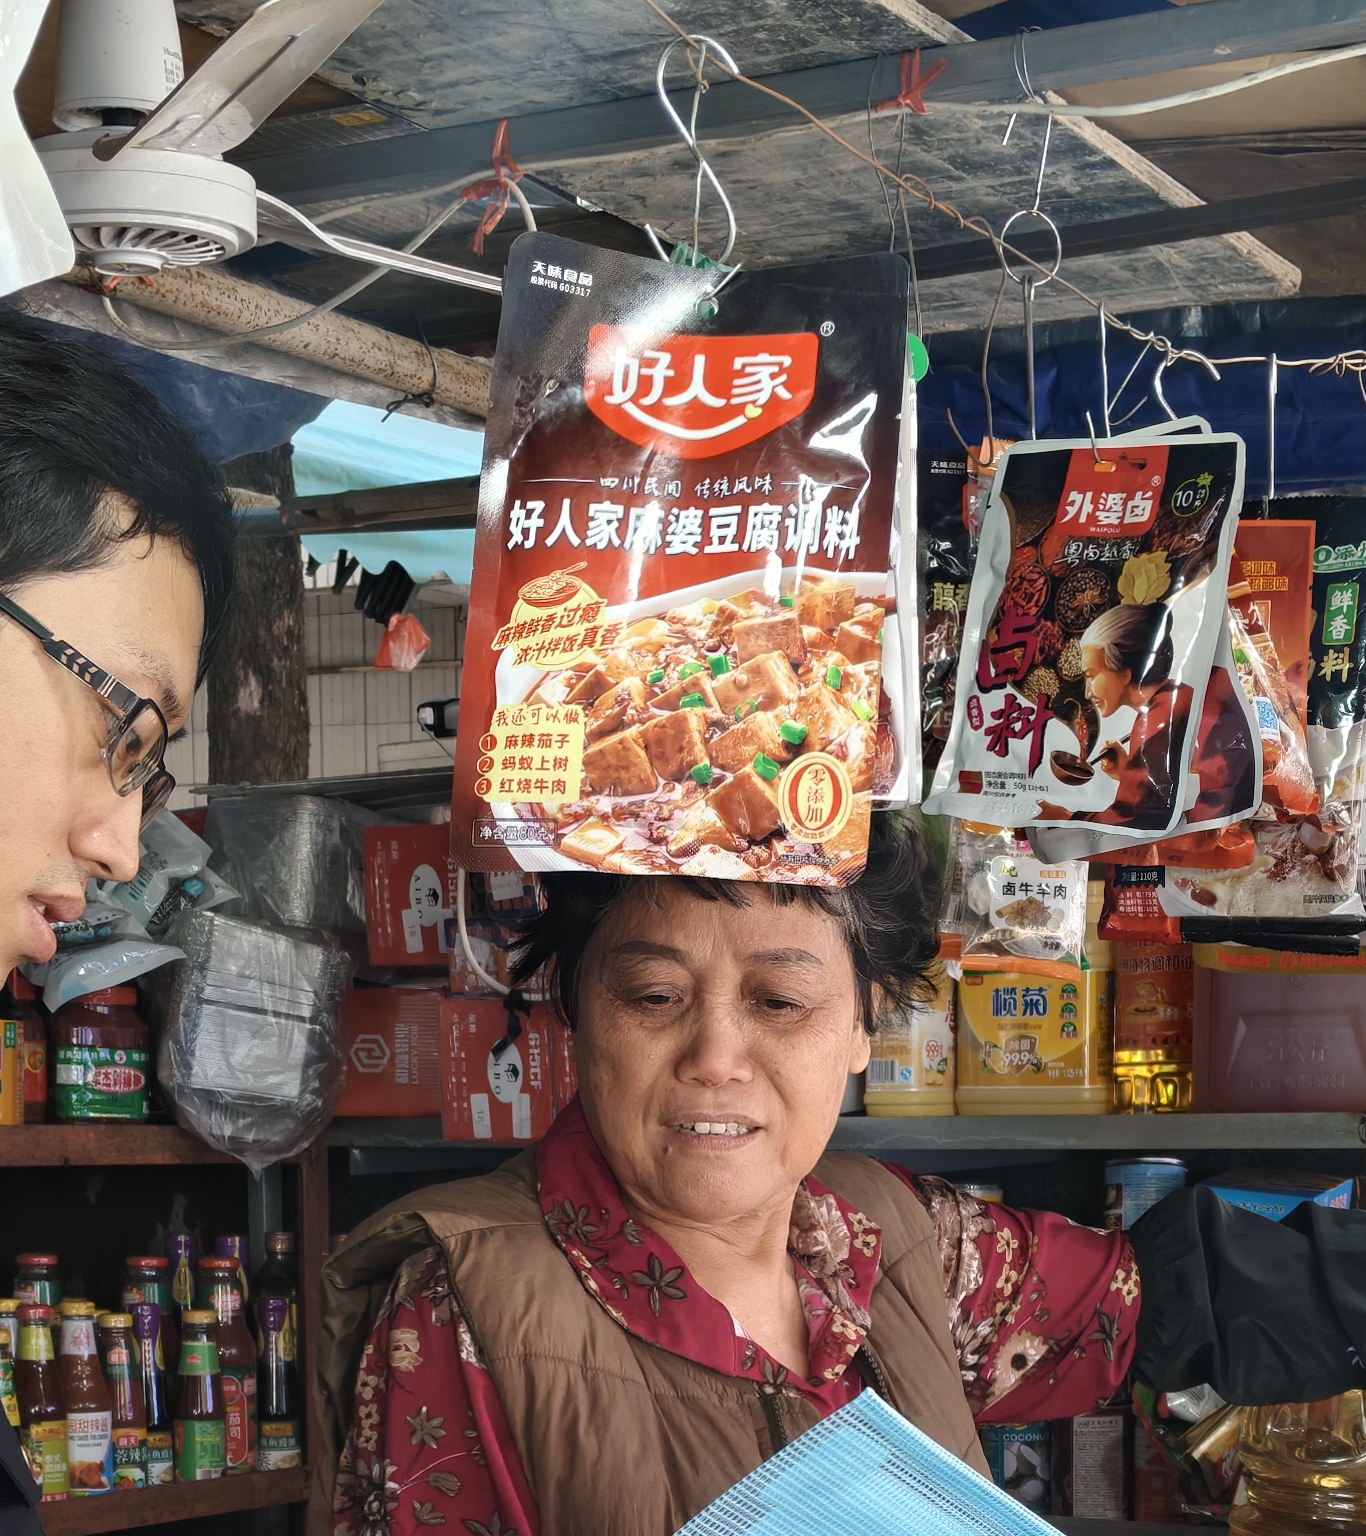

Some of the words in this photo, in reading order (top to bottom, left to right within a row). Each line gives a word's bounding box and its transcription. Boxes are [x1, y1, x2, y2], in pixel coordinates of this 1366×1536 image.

[531, 260, 593, 287] 天味食品
[558, 281, 592, 298] 603317
[603, 351, 794, 407] 好人家
[598, 474, 682, 499] 四川民间
[694, 474, 774, 499] 传统风味
[1058, 489, 1155, 526] 外婆卤
[506, 498, 861, 559] 好人家麻婆豆腐调料
[496, 599, 604, 649] 麻辣鲜香过瘾
[1329, 588, 1354, 641] 鲜香
[512, 621, 623, 666] 浓汁拌饭真香
[494, 705, 582, 728] 我还可以做
[503, 733, 571, 751] 麻辣茄子
[501, 755, 569, 774] 蚂蚁上树
[497, 777, 568, 797] 红烧牛肉
[803, 767, 827, 824] 零添加
[478, 824, 550, 843] 净含量80克
[1001, 880, 1068, 900] 卤牛羊肉
[992, 986, 1048, 1018] 榄菊
